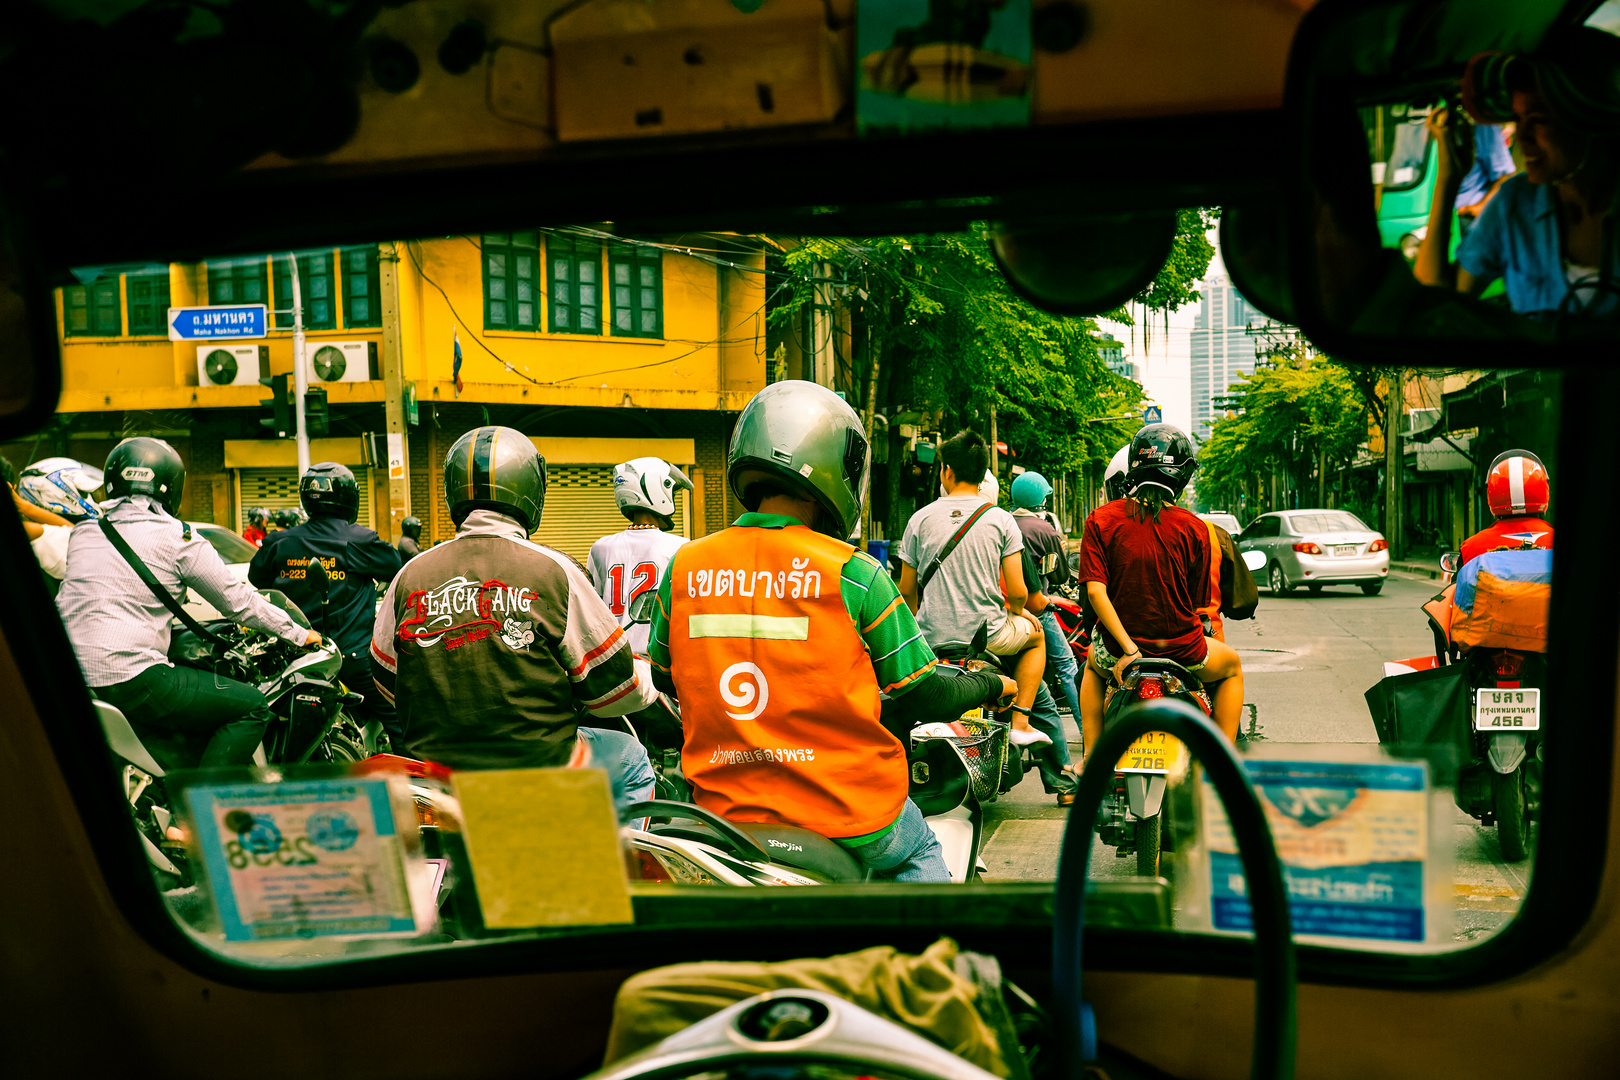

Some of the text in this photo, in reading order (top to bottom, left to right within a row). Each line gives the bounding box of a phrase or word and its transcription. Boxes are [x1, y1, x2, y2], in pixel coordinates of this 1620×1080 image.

[193, 311, 255, 326] ถ.มหานคร
[193, 326, 255, 336] Maha Nakhon Rd.
[125, 470, 149, 478] STM
[687, 557, 822, 599] เขตบางรัก
[1480, 707, 1536, 716] กรุงเทพมหานคร
[1491, 716, 1523, 727] 456
[1131, 757, 1165, 769] 706
